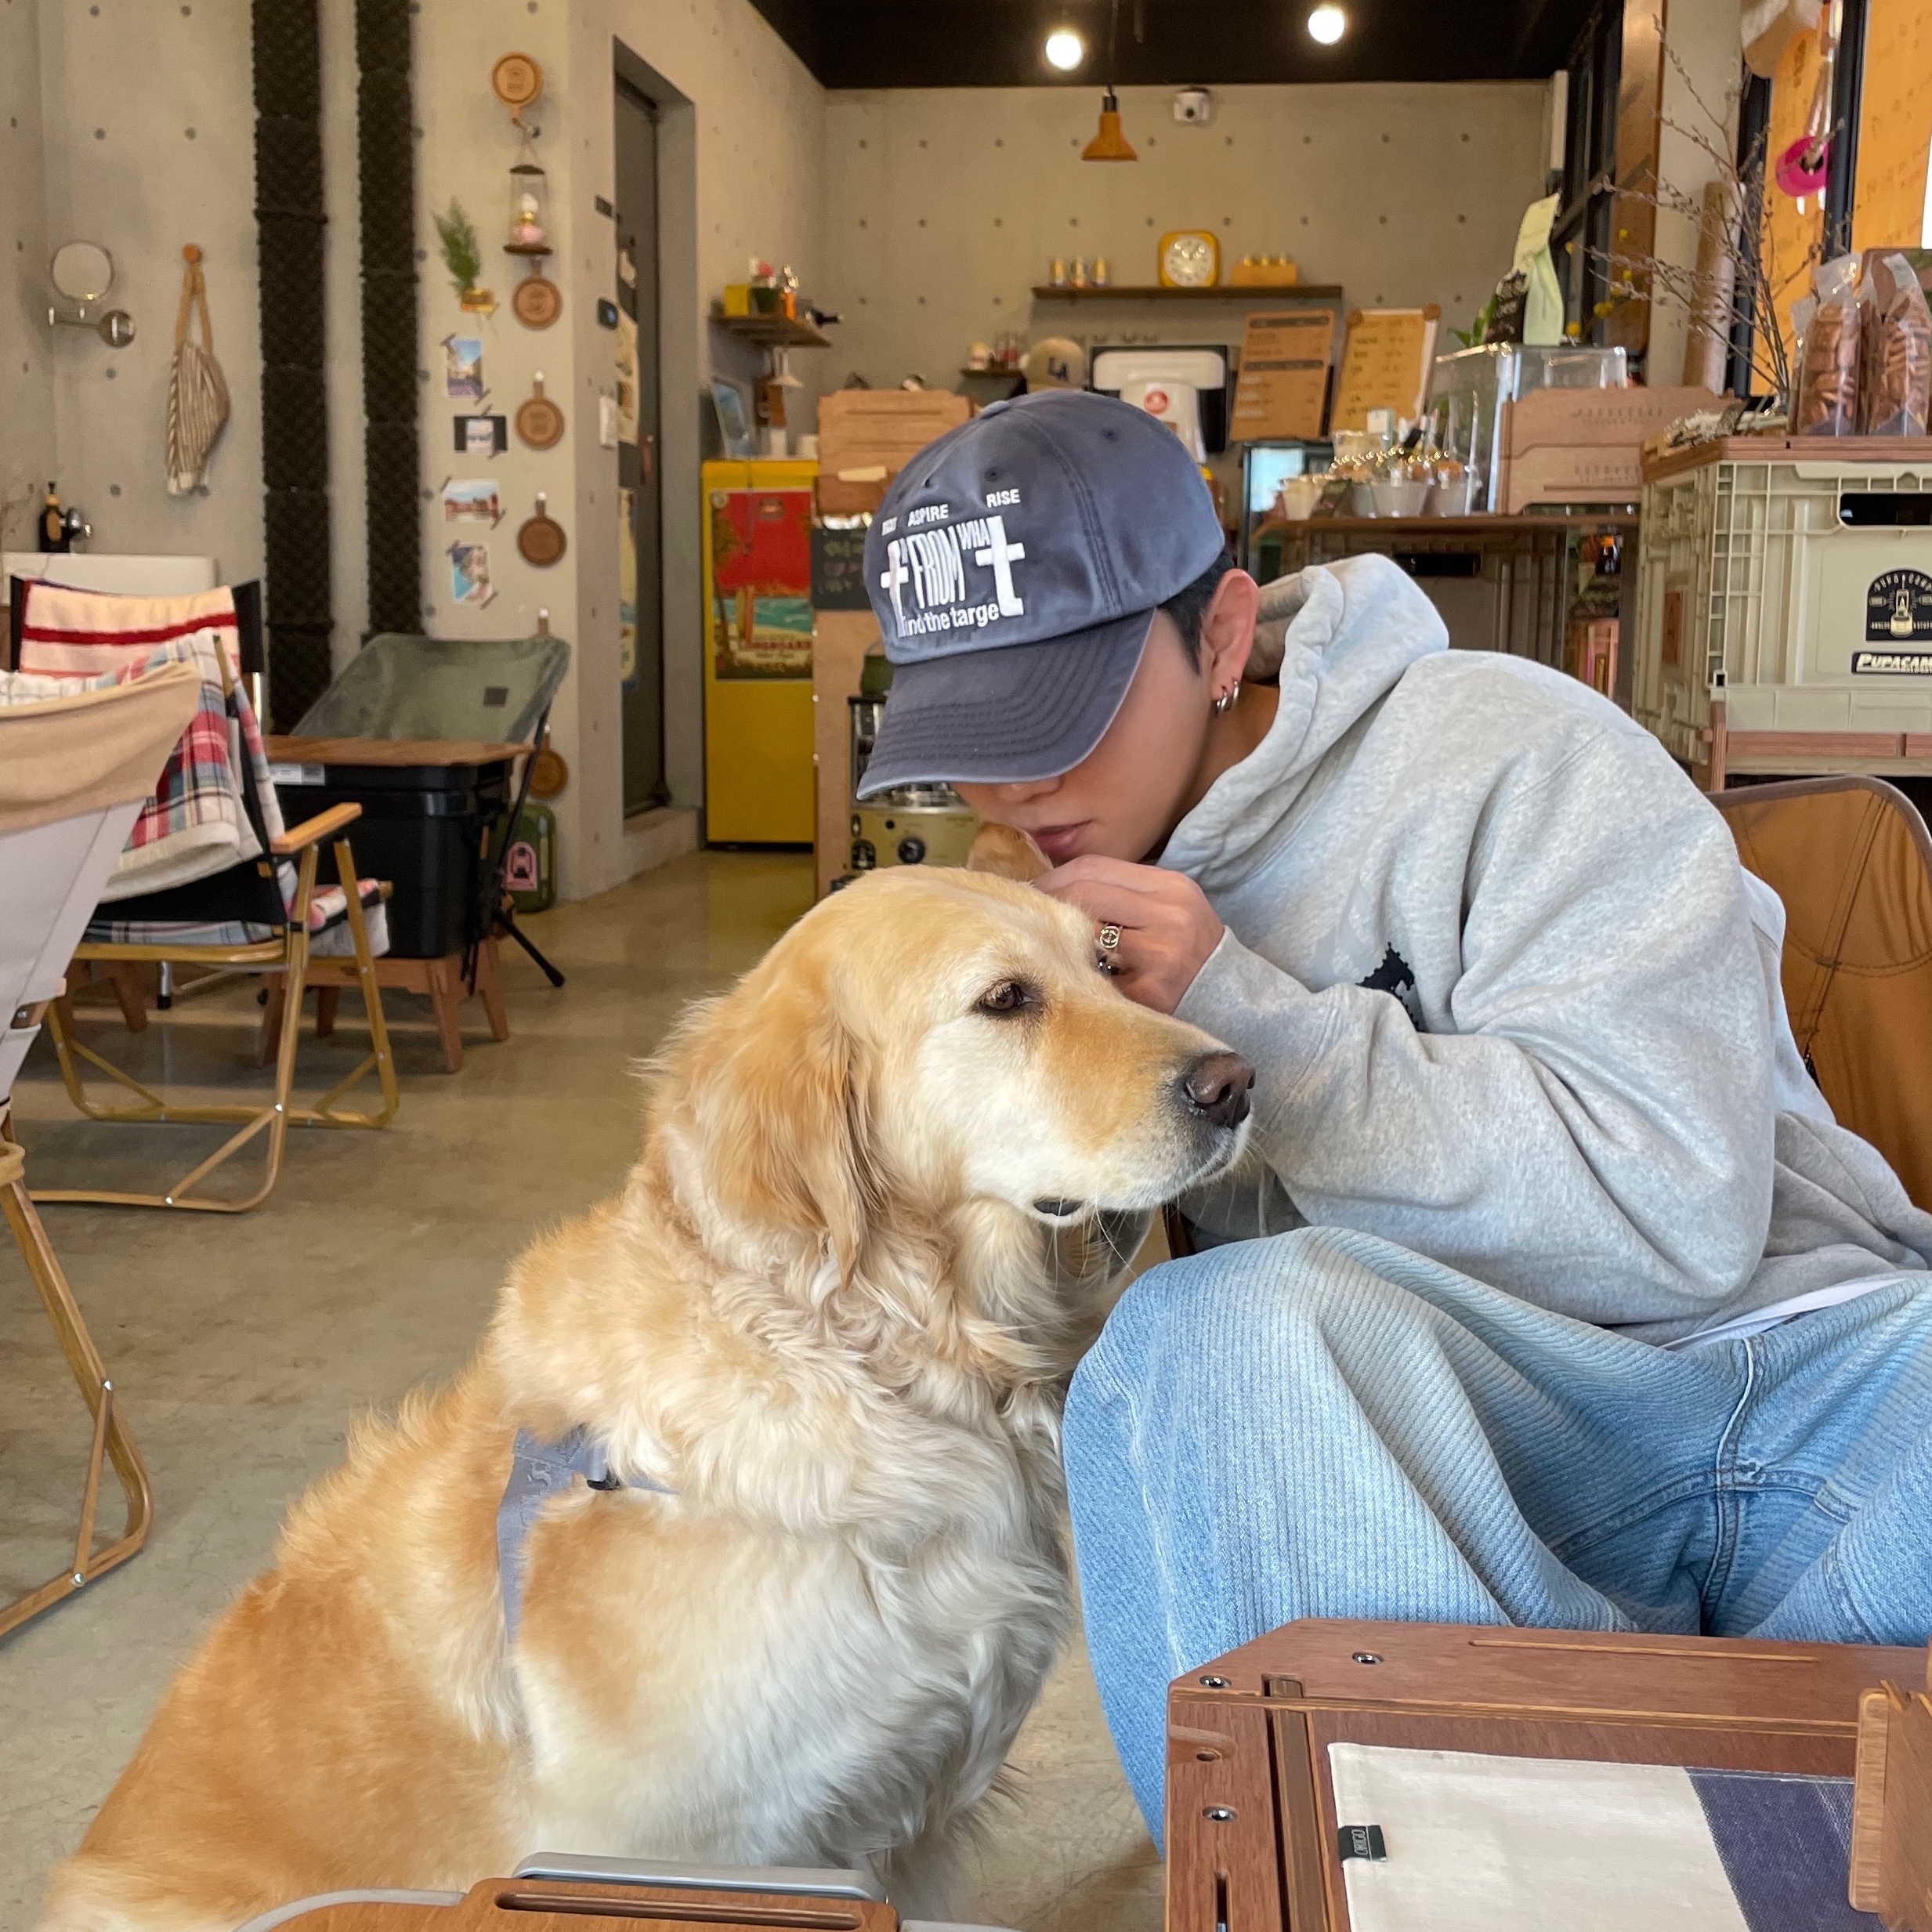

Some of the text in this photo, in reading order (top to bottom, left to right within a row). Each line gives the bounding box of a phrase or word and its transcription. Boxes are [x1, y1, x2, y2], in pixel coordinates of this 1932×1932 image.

[907, 504, 949, 526] ASPIRE
[986, 488, 1021, 508] RISE
[906, 526, 966, 609] FROM
[924, 610, 951, 631] the
